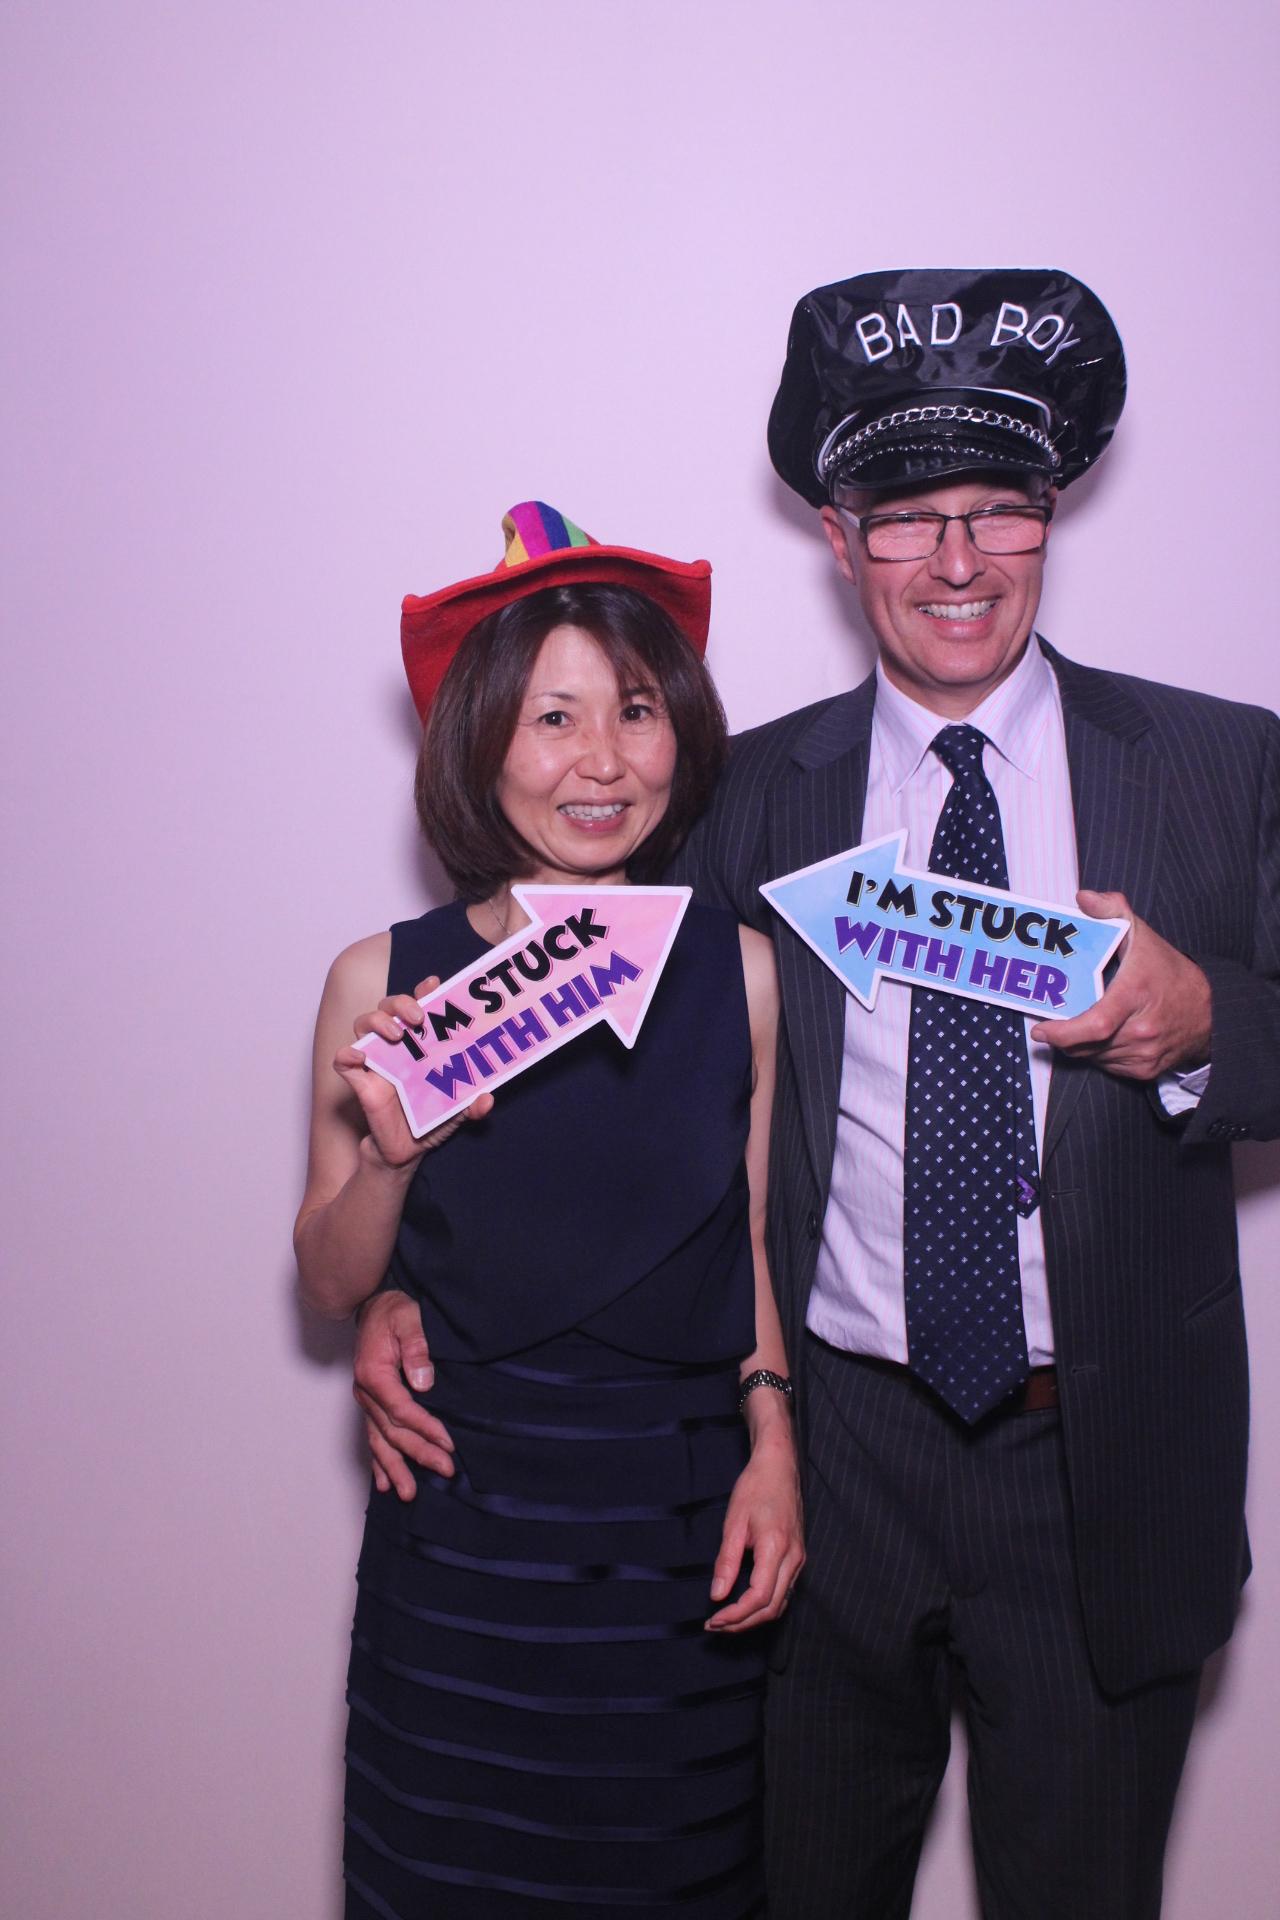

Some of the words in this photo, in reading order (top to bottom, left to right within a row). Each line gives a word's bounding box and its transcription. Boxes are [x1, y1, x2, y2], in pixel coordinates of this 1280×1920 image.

[855, 302, 963, 366] BAD
[990, 302, 1081, 366] BOY
[846, 871, 918, 918] I'M
[929, 890, 1080, 958] STUCK
[399, 999, 475, 1062] I'M
[468, 907, 611, 1014] STUCK
[834, 916, 965, 982] WITH
[968, 949, 1070, 1009] HER
[424, 1007, 552, 1100] WITH
[539, 950, 644, 1028] HIM
